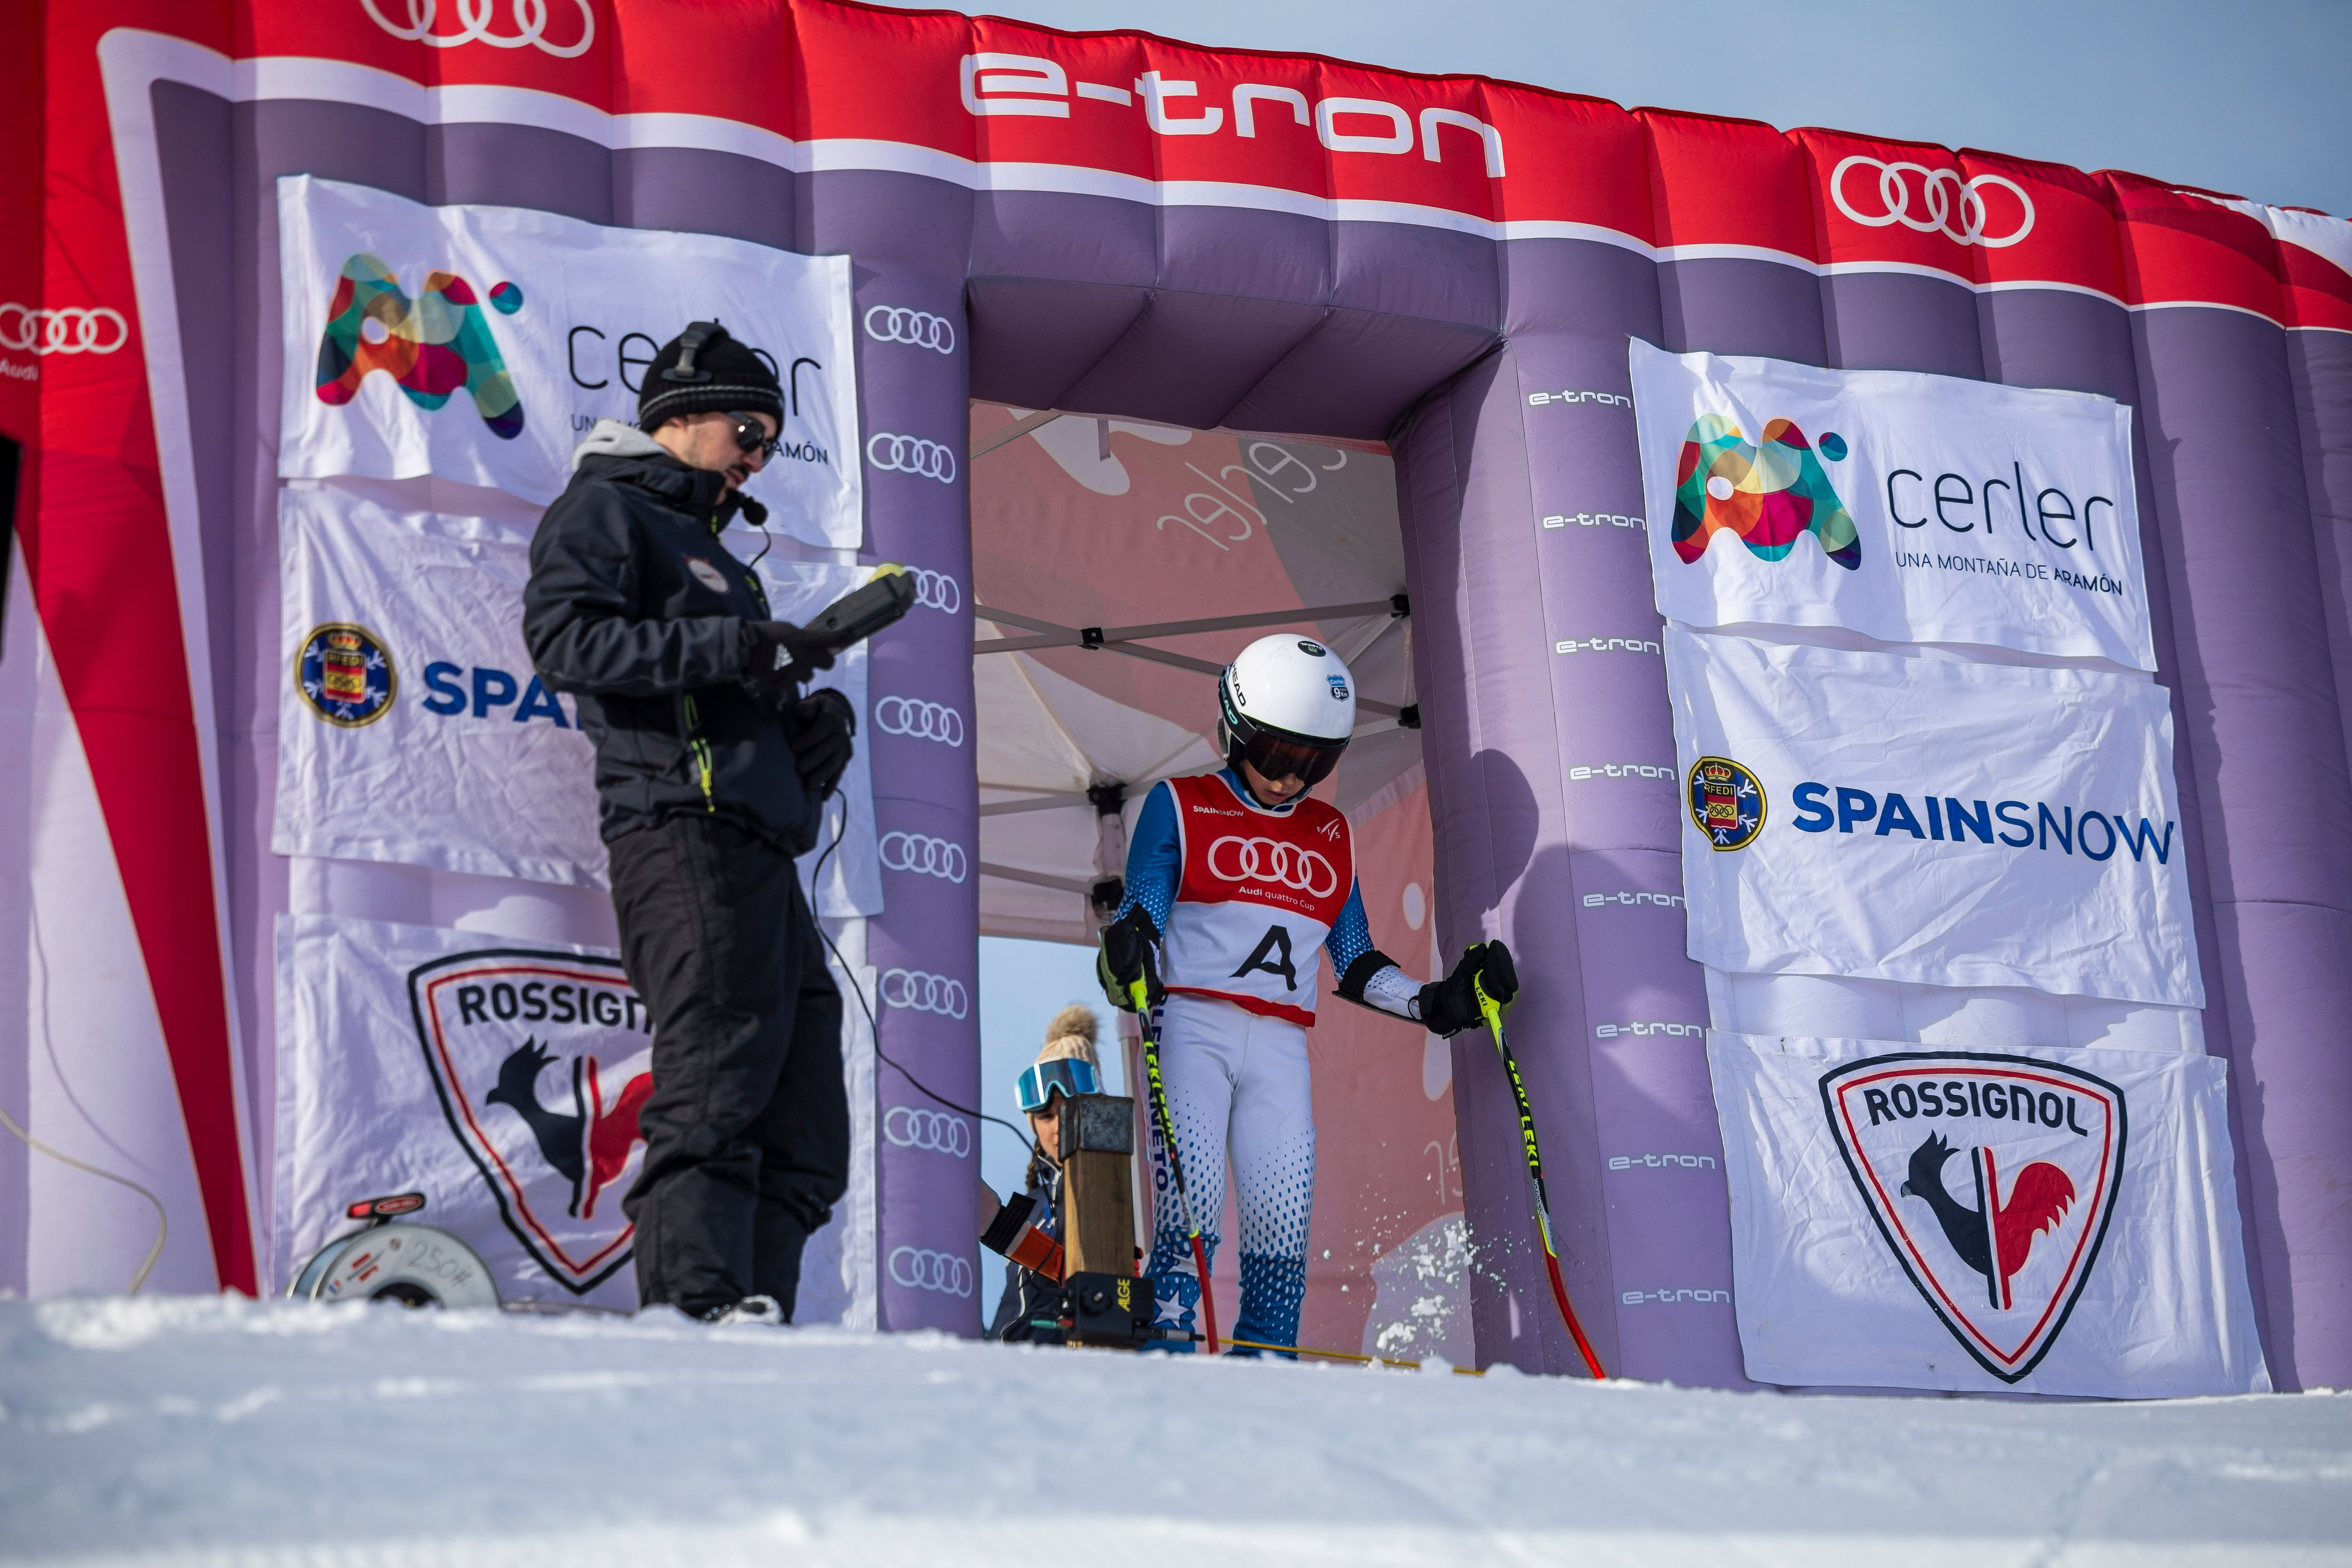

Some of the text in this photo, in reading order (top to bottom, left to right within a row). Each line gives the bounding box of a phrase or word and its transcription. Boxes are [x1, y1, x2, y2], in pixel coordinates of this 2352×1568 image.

[960, 52, 1506, 178] e-tron
[1529, 390, 1631, 408] e-tron
[1887, 461, 2114, 551] cerler
[1543, 513, 1646, 531] e-tron
[1895, 551, 2123, 596] UNA MONTAÑA DE ARAMÓN
[1556, 638, 1661, 654] e-tron
[1232, 661, 1247, 707] HEAD
[1334, 688, 1341, 698] 9
[1570, 764, 1676, 781] e-tron
[1705, 785, 1733, 795] RFEDI
[1792, 782, 2174, 865] SPAINSNOW
[1239, 886, 1315, 911] Audi quattro Cup
[1583, 891, 1686, 907] e-tron
[1229, 925, 1297, 992] A
[1476, 987, 1487, 1006] LEKI
[457, 981, 655, 1035] ROSSIGN
[1597, 1022, 1703, 1038] e-tron
[1862, 1080, 2088, 1137] ROSSIGNOL
[1521, 1116, 1539, 1166] LEKI
[1609, 1154, 1716, 1170] e-tron
[1117, 1278, 1130, 1312] ALGE
[1622, 1289, 1730, 1305] e-tron
